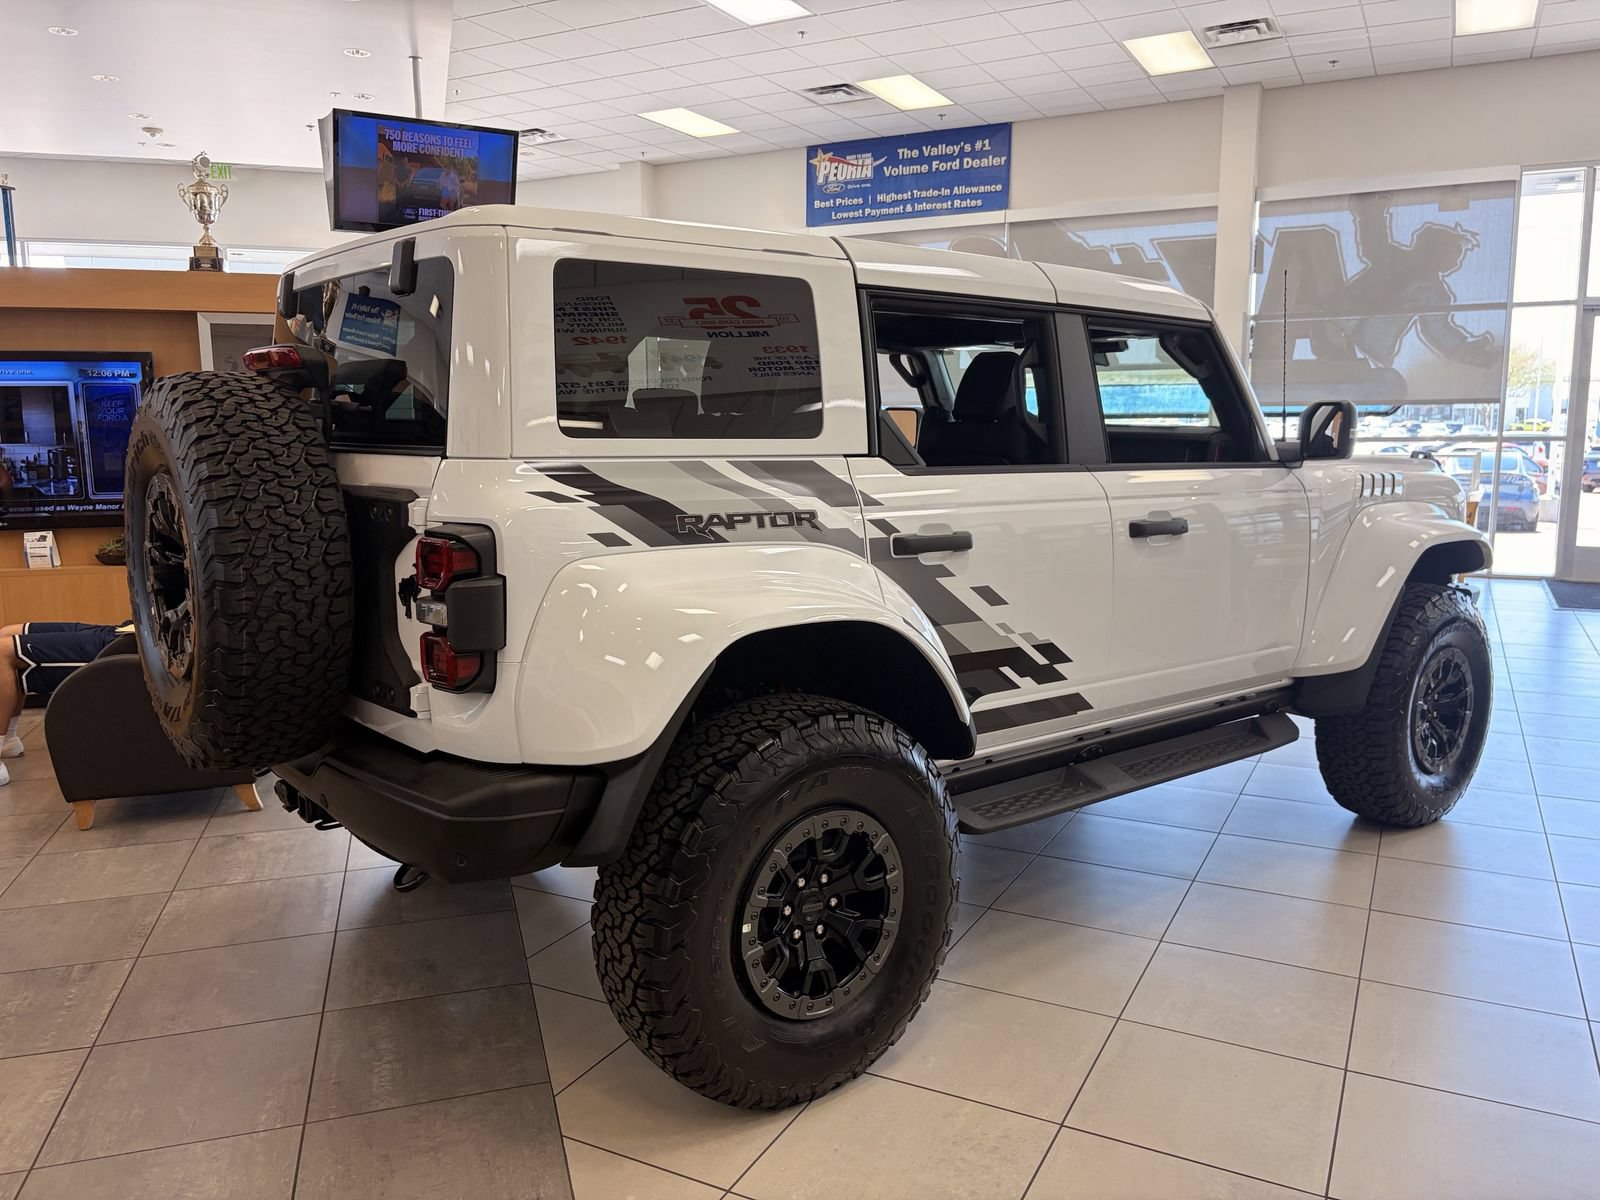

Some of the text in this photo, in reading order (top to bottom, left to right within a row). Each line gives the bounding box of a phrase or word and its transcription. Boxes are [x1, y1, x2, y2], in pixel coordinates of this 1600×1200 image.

[384, 128, 473, 149] 750 REASONS TO FEEL
[392, 140, 466, 159] MORE CONFIDENT
[897, 139, 991, 160] The Valley's #1
[210, 164, 232, 180] EXIT
[883, 155, 1007, 177] Volume Ford Dealer
[876, 183, 1003, 203] Highest Trade-In Allowance
[814, 197, 864, 209] Best Prices
[831, 199, 983, 220] Lowest Payment & Interest Rates
[87, 369, 130, 377] 12:06 PM
[101, 399, 124, 407] KEEP
[101, 407, 125, 415] YOUR
[35, 504, 54, 512] used
[67, 504, 94, 513] Wayne
[95, 503, 120, 511] Manor
[676, 509, 825, 541] RAPTOR
